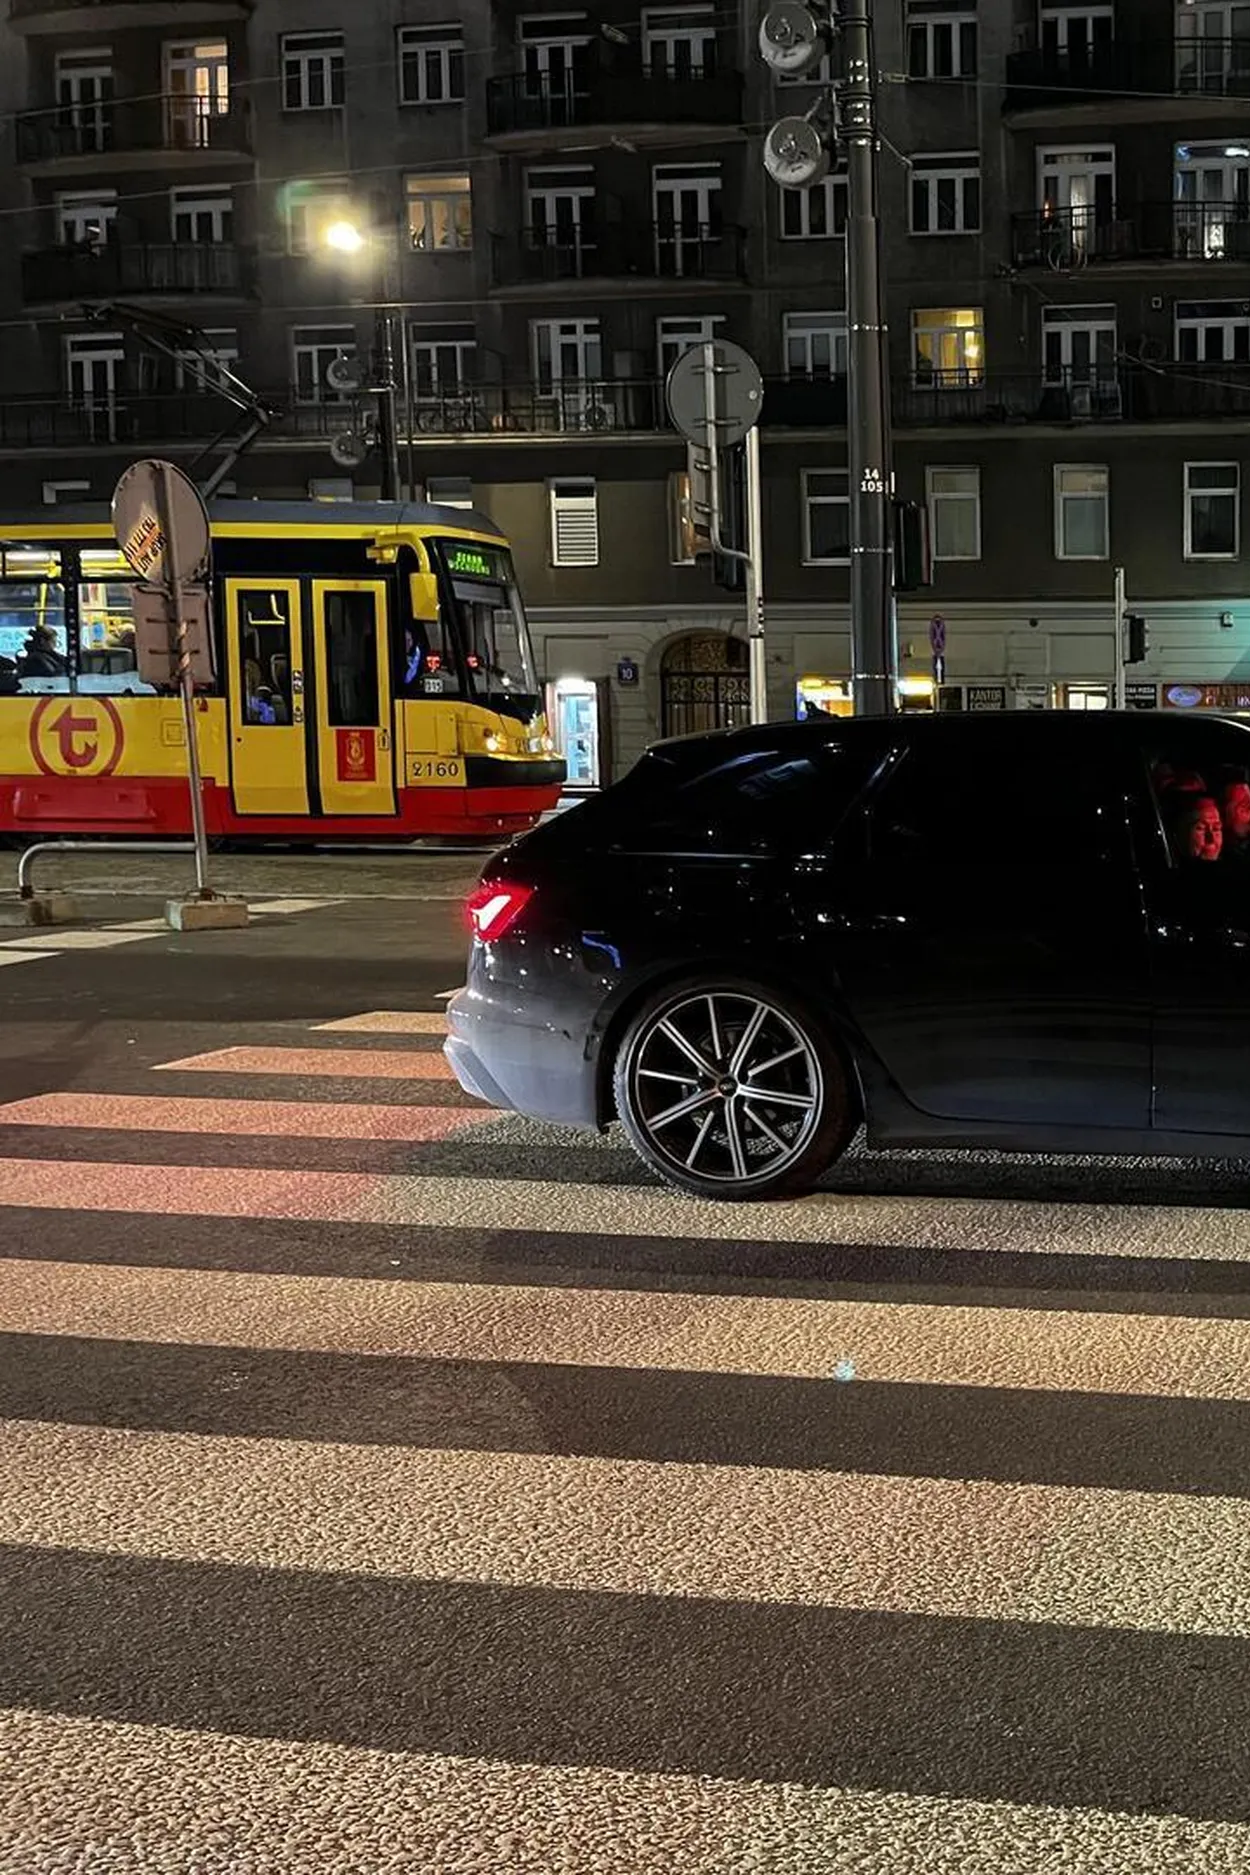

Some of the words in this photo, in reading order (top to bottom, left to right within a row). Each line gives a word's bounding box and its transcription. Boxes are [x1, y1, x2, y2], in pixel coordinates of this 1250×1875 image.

[864, 468, 879, 480] 14
[860, 480, 883, 493] 105
[412, 762, 459, 777] 2160
